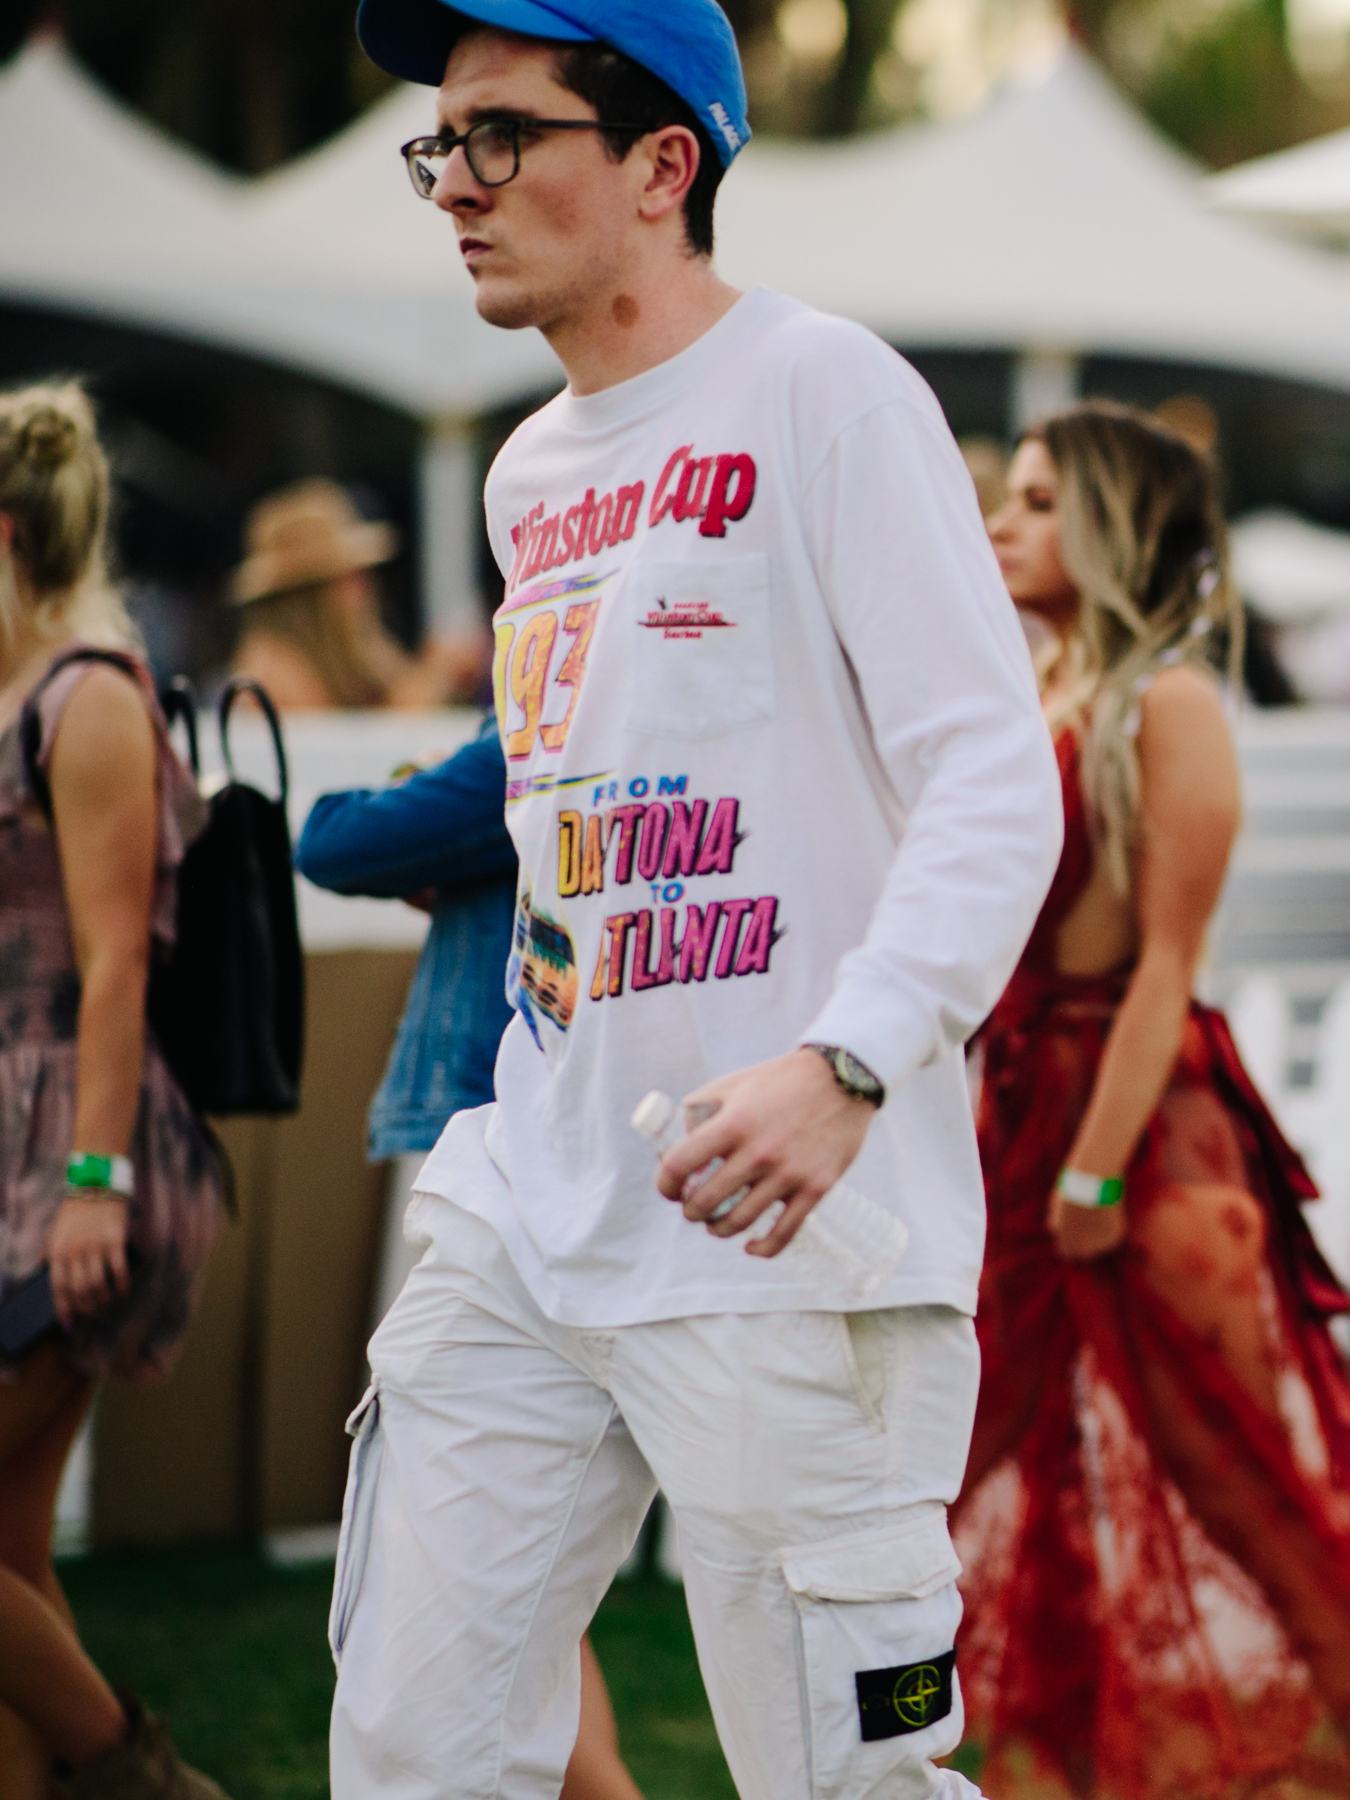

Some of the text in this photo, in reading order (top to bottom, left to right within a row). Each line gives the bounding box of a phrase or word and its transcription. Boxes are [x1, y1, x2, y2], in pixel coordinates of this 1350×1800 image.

[649, 443, 756, 538] Cup
[593, 775, 689, 807] FROM
[650, 883, 685, 904] TO
